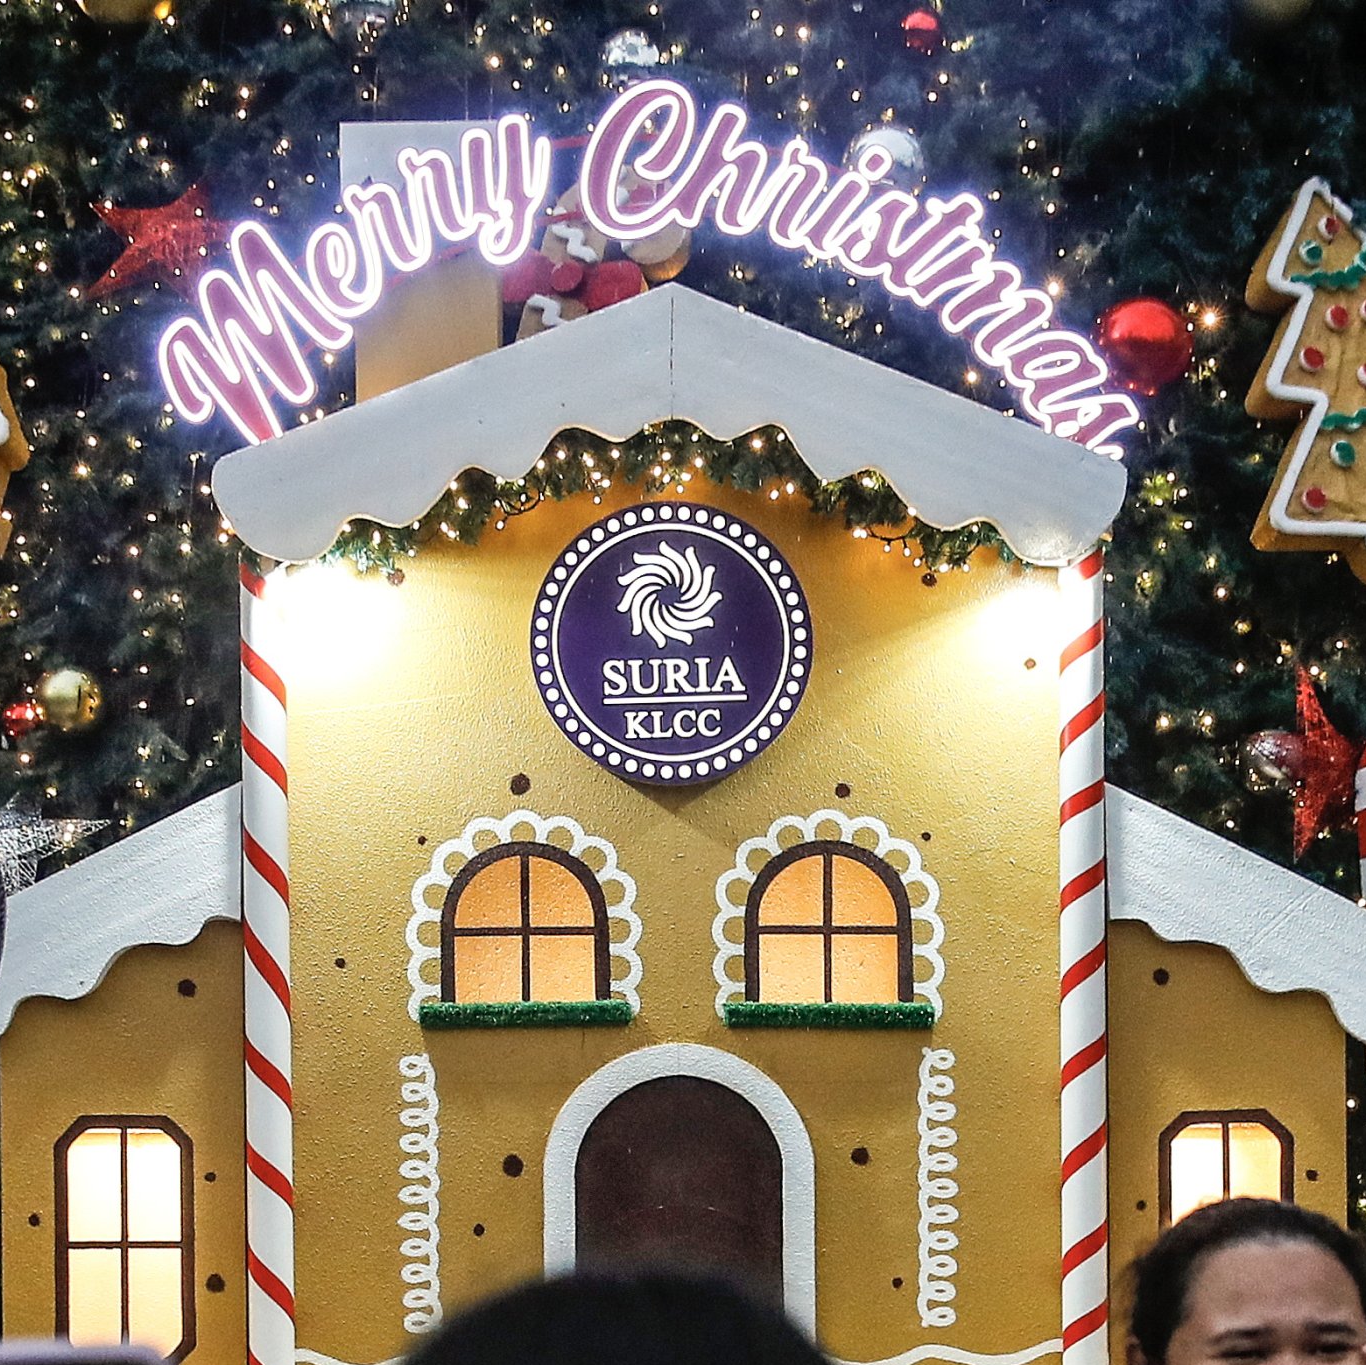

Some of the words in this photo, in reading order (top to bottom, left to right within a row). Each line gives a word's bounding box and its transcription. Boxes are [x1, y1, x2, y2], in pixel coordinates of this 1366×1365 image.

[158, 113, 549, 446] Merry
[583, 79, 1140, 461] Christmas
[602, 656, 746, 696] SURIA
[624, 708, 723, 740] KLCC
